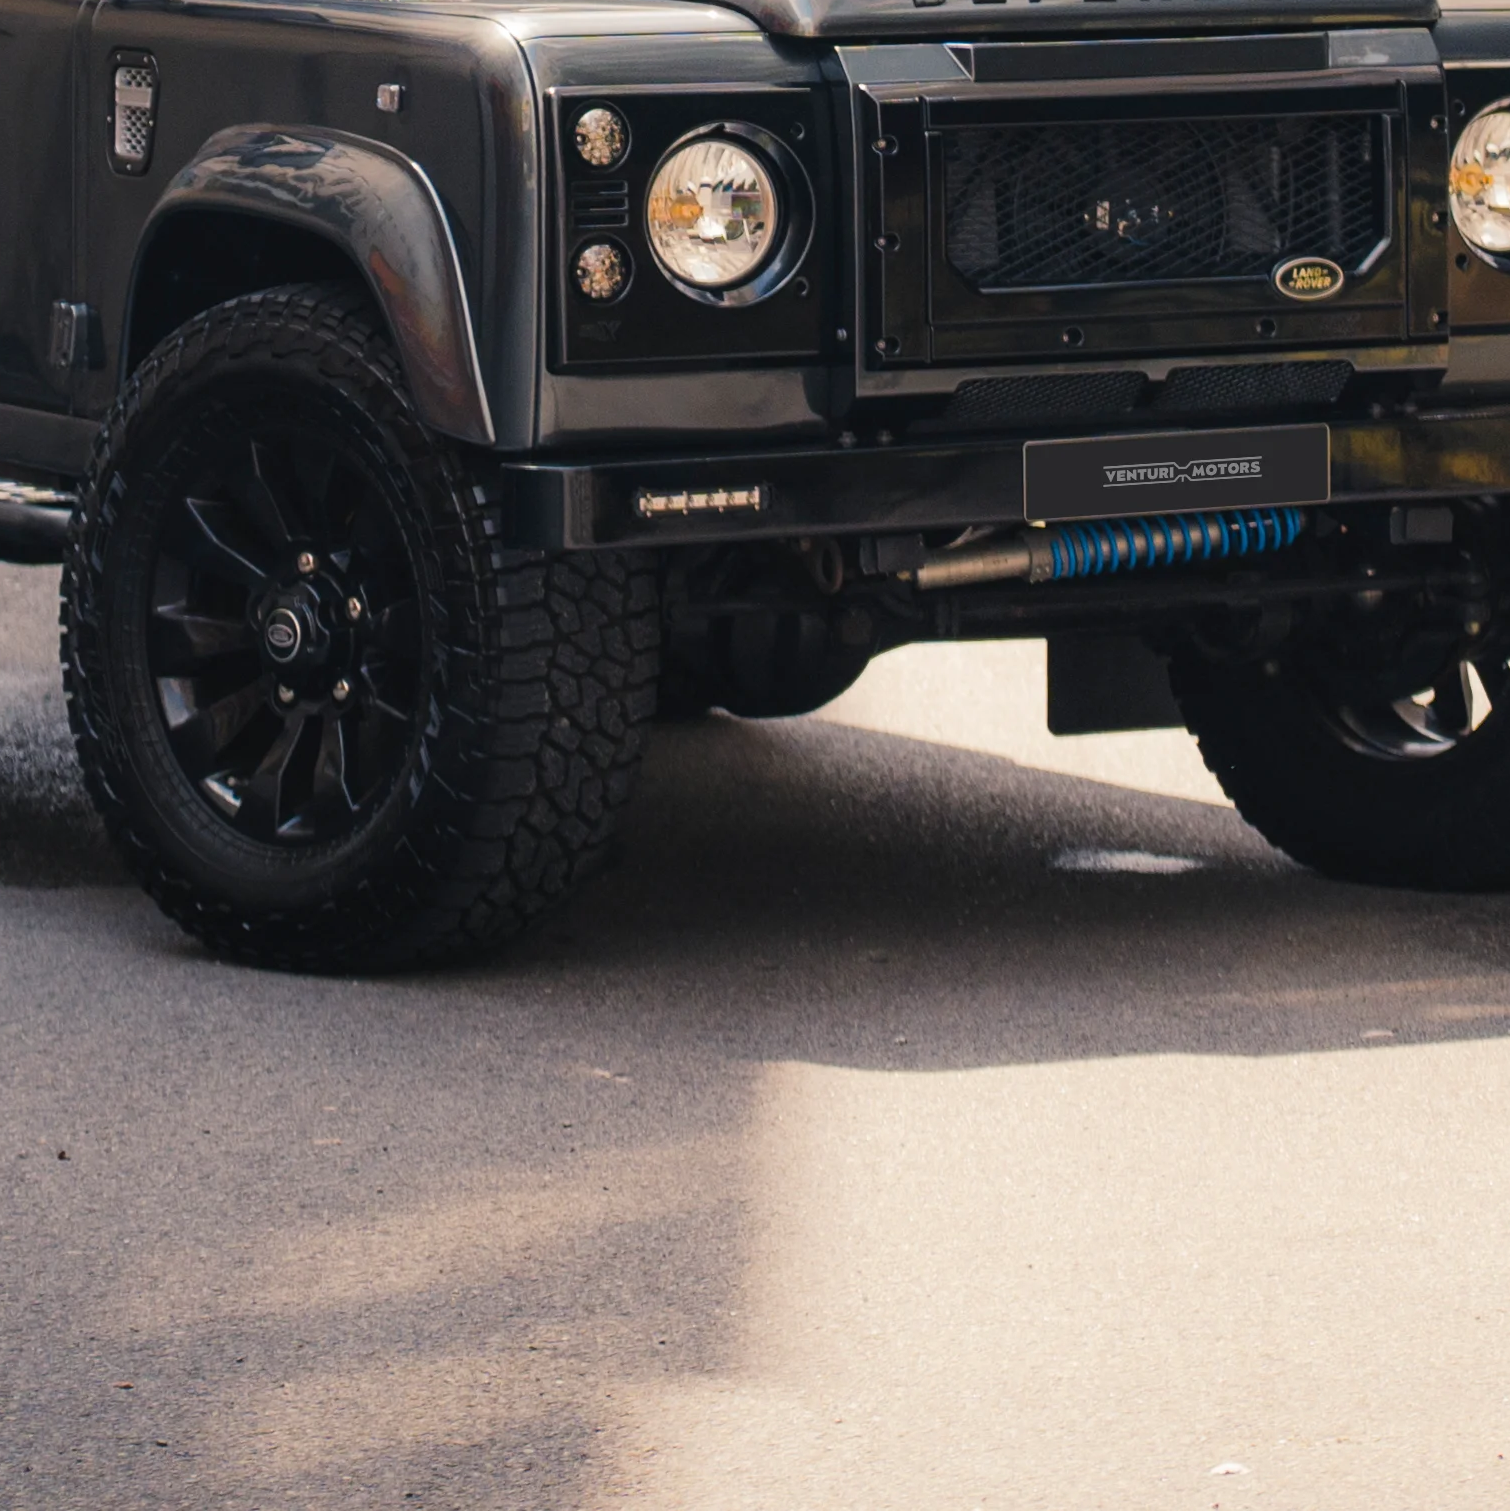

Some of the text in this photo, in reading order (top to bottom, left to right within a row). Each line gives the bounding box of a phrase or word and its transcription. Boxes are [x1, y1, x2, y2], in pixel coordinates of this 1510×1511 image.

[1292, 267, 1322, 279] LAND
[1295, 276, 1332, 290] ROVER
[1105, 461, 1261, 483] VENTURI MOTORS
